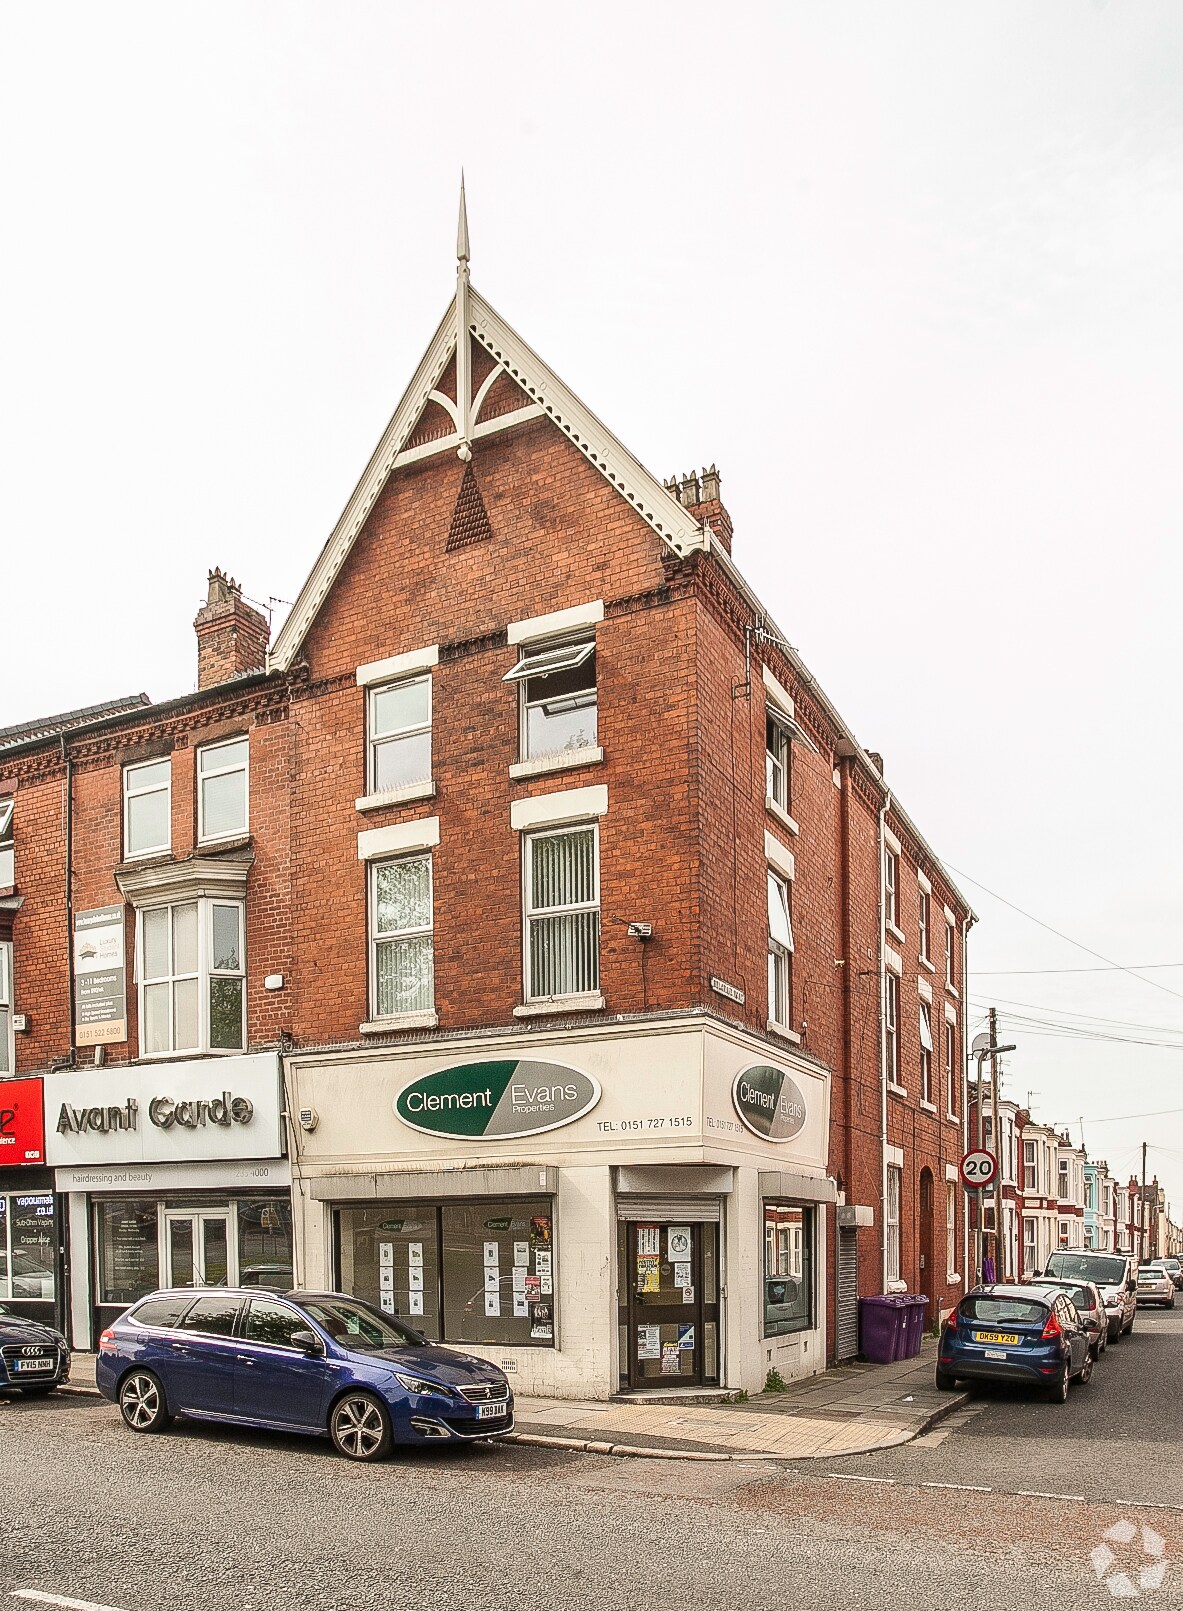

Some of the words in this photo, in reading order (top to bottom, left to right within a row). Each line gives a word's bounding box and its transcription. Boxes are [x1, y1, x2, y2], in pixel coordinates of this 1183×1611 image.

[79, 1030, 93, 1039] 0151
[94, 1029, 105, 1037] 522
[406, 1087, 492, 1112] Clement
[511, 1083, 578, 1104] Evans
[740, 1081, 775, 1110] Clement
[780, 1096, 802, 1118] Evans
[56, 1097, 139, 1134] Avant
[148, 1091, 254, 1129] Garde
[512, 1102, 555, 1114] Properties
[597, 1121, 618, 1132] TEL:
[621, 1119, 643, 1131] 0151
[647, 1118, 665, 1129] 727
[669, 1116, 692, 1128] 1515
[965, 1160, 992, 1176] 20
[72, 1174, 113, 1185] hairdressing
[113, 1172, 127, 1181] and
[128, 1171, 153, 1183] beauty
[37, 1218, 54, 1228] Vaping
[979, 1332, 999, 1341] DK59
[20, 1360, 37, 1369] FY15
